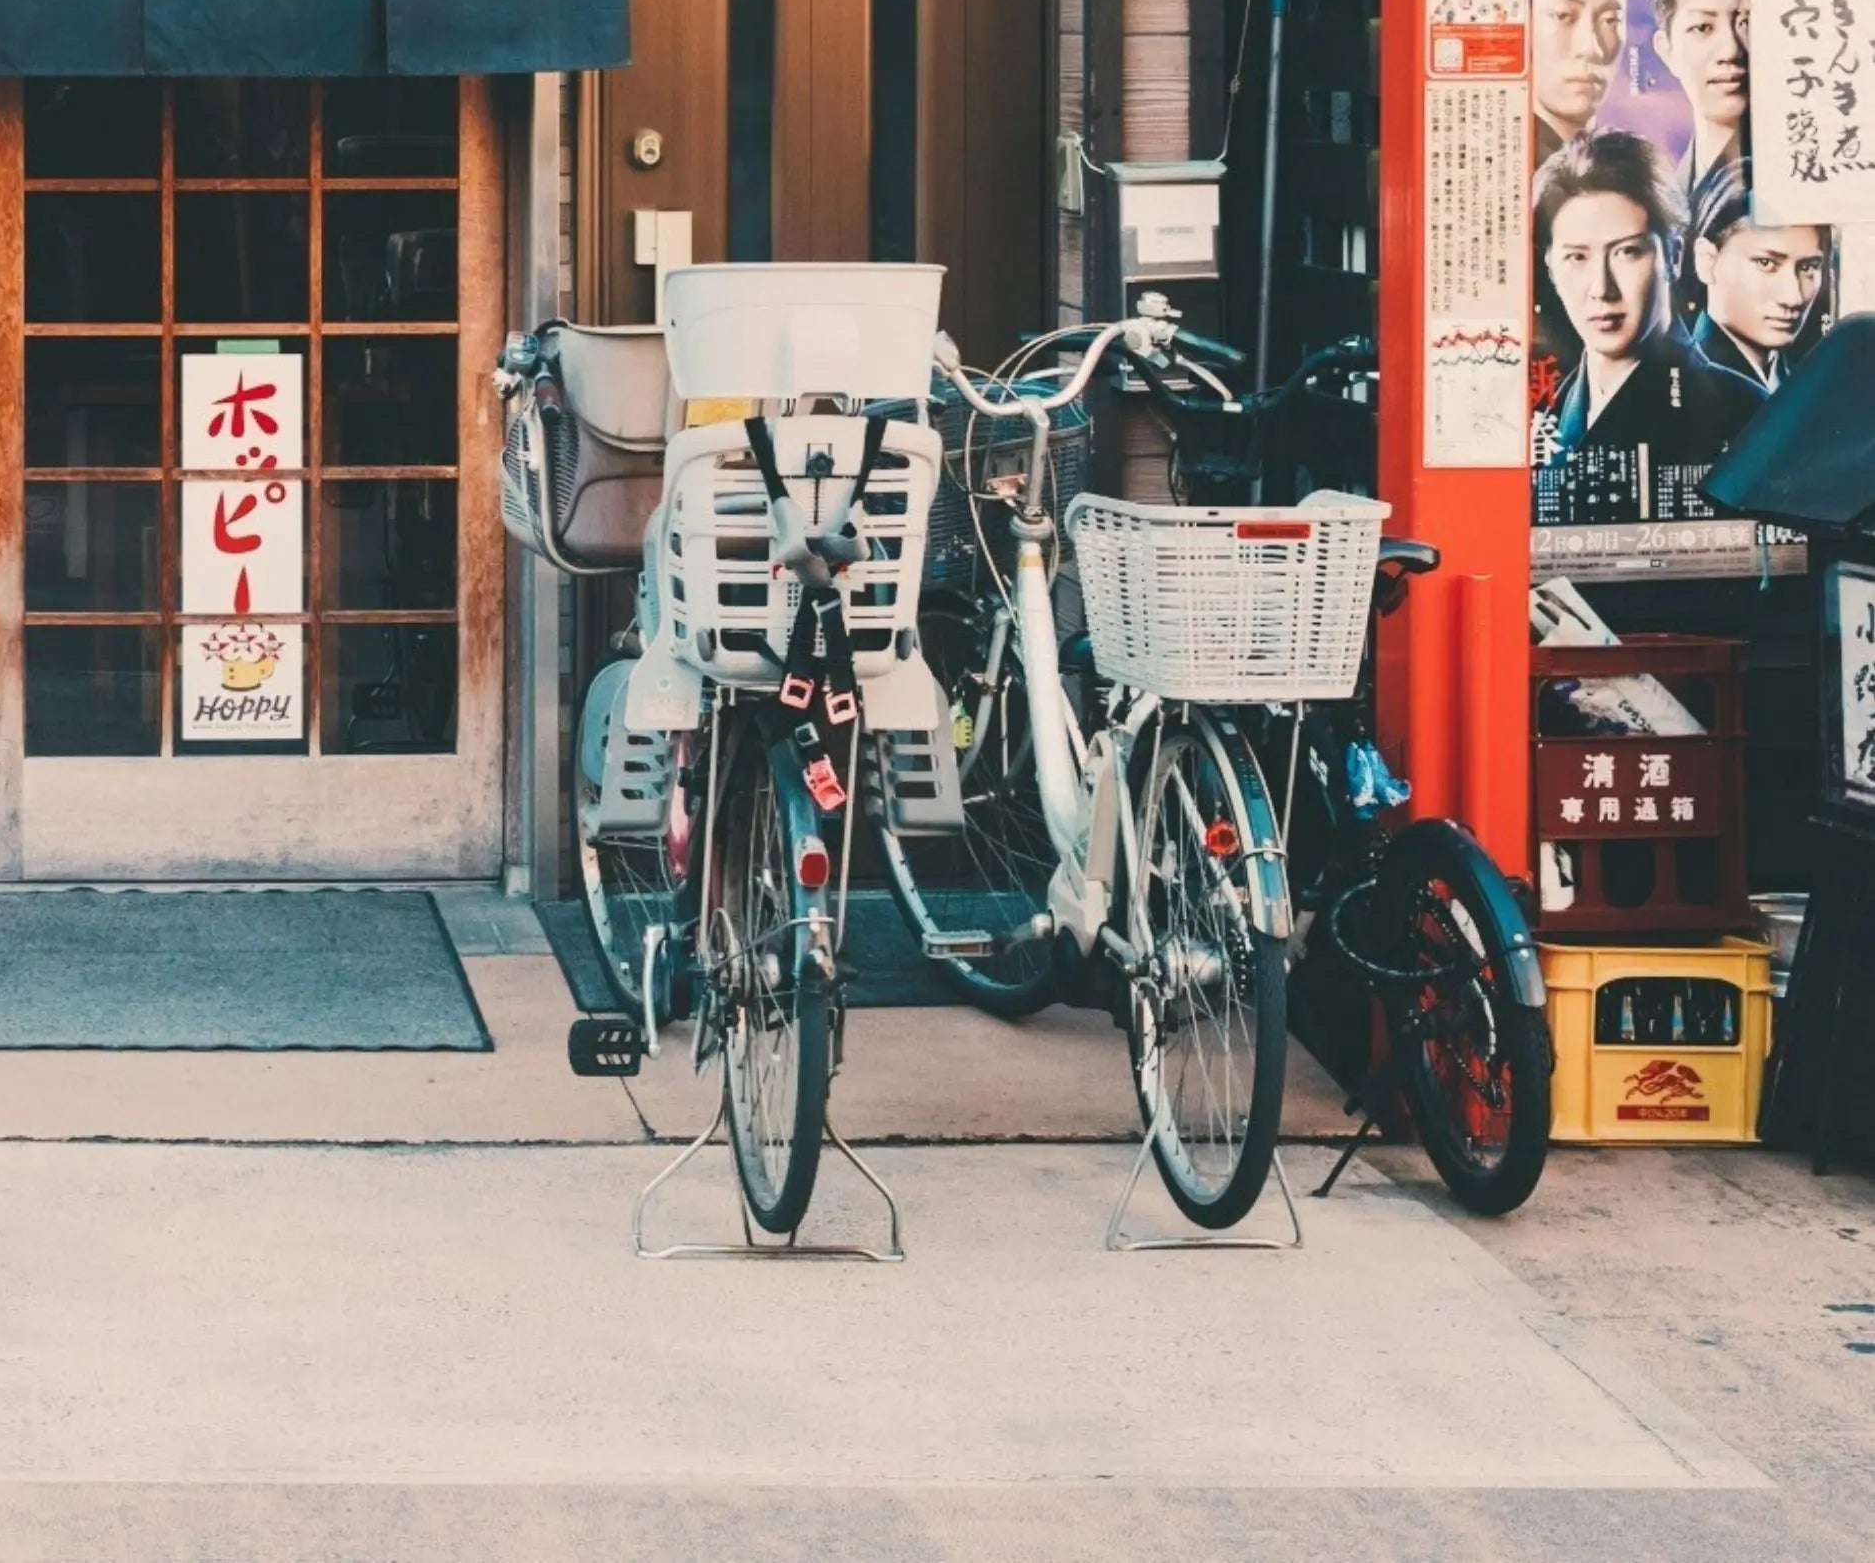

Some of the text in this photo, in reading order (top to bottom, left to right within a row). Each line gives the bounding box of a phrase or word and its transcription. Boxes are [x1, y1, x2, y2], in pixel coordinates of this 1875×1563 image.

[208, 370, 286, 614] ホッピー
[1582, 752, 1671, 788] 清酒
